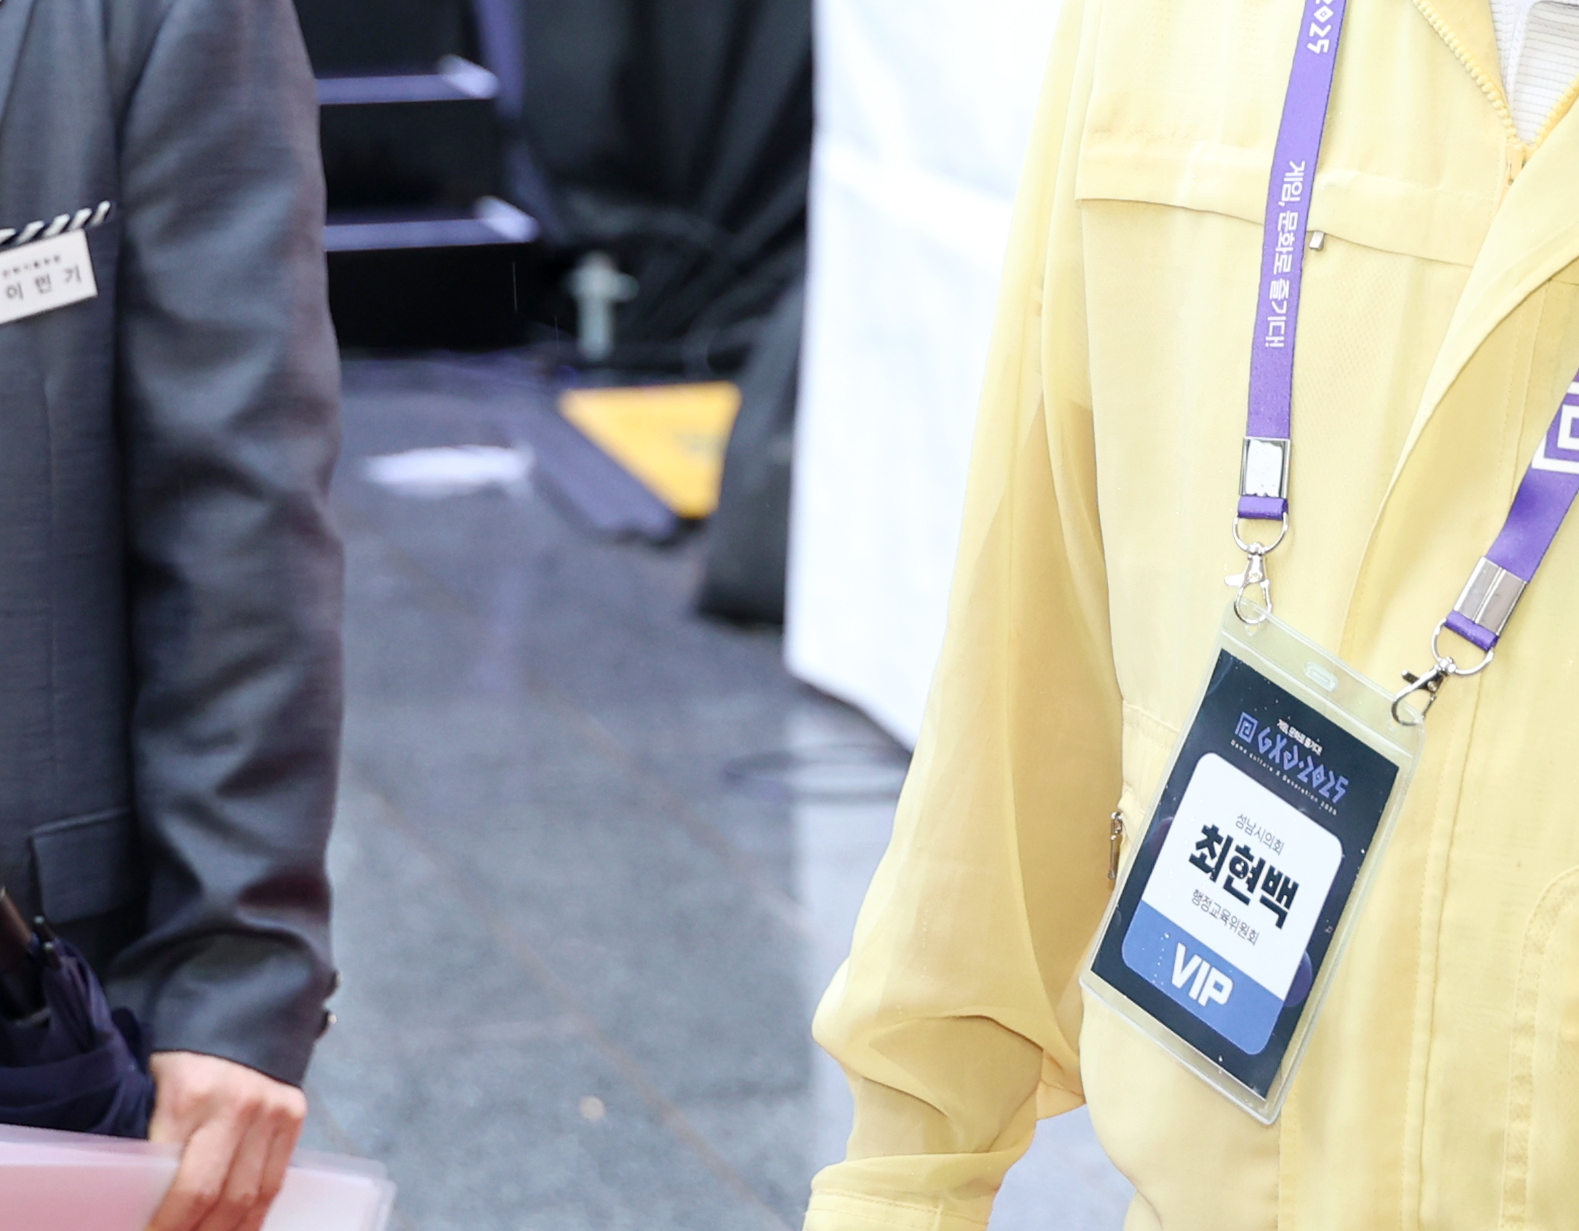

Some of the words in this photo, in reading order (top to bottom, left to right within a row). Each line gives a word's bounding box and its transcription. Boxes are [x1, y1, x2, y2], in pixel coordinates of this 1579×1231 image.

[1277, 160, 1306, 207] 게임,
[1273, 210, 1299, 275] 문화로
[1264, 278, 1290, 348] 즐기다!
[1235, 813, 1285, 856] 성남시의회
[1188, 823, 1300, 930] 최현백
[1191, 888, 1260, 946] 행정교육위원회
[1171, 941, 1234, 1007] VIP
